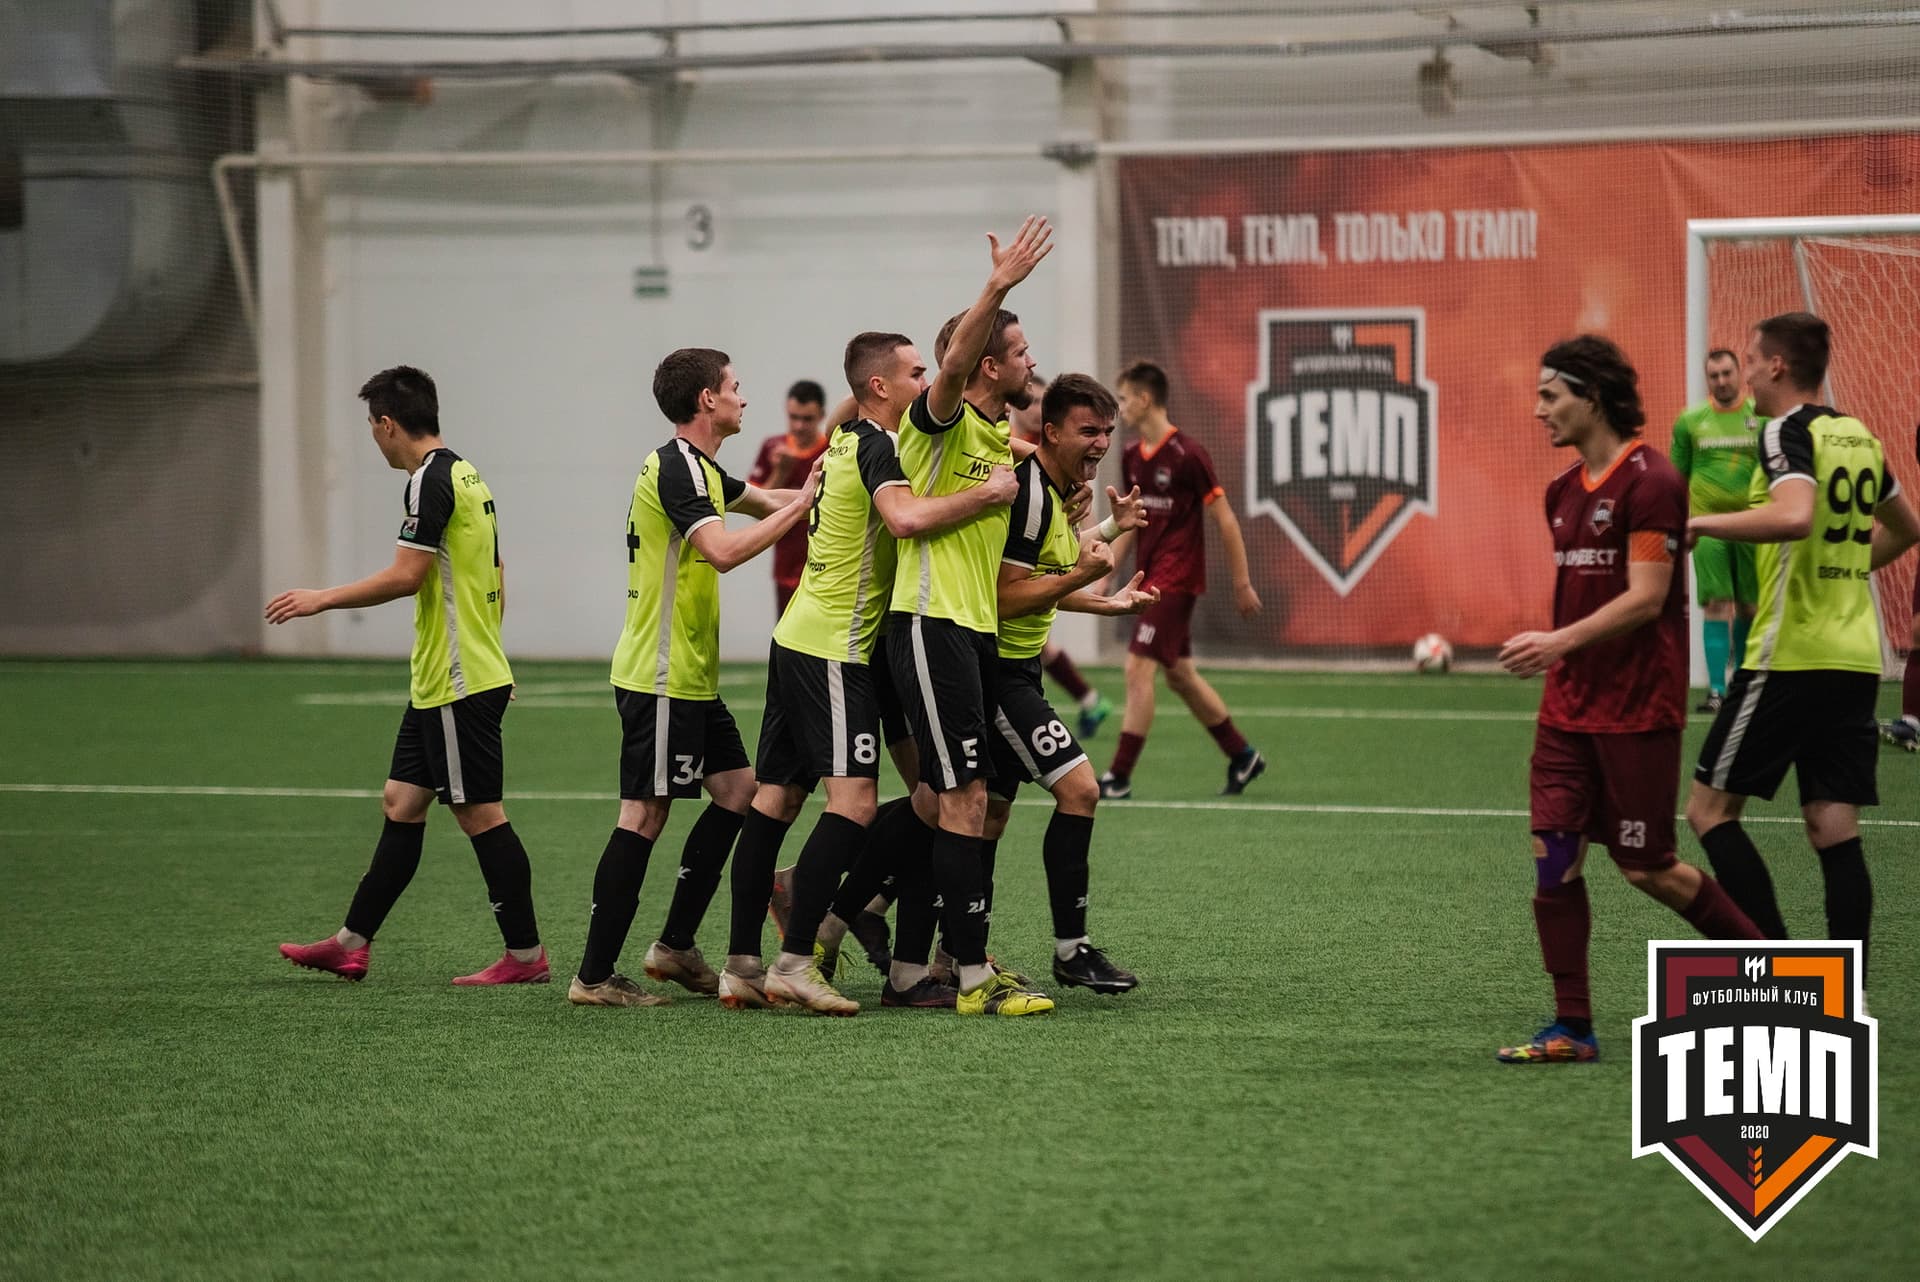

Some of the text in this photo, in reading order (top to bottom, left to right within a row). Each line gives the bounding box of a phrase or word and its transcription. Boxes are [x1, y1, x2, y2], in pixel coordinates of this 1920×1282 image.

[685, 204, 714, 252] 3
[1336, 210, 1445, 263] ТОЛЬКО
[1454, 208, 1537, 260] ТЕМП!
[1266, 389, 1419, 486] ТЕМП
[1824, 466, 1877, 545] 99
[854, 733, 876, 764] 8
[962, 738, 978, 768] 5
[1032, 720, 1071, 756] 69
[1620, 820, 1646, 848] 23
